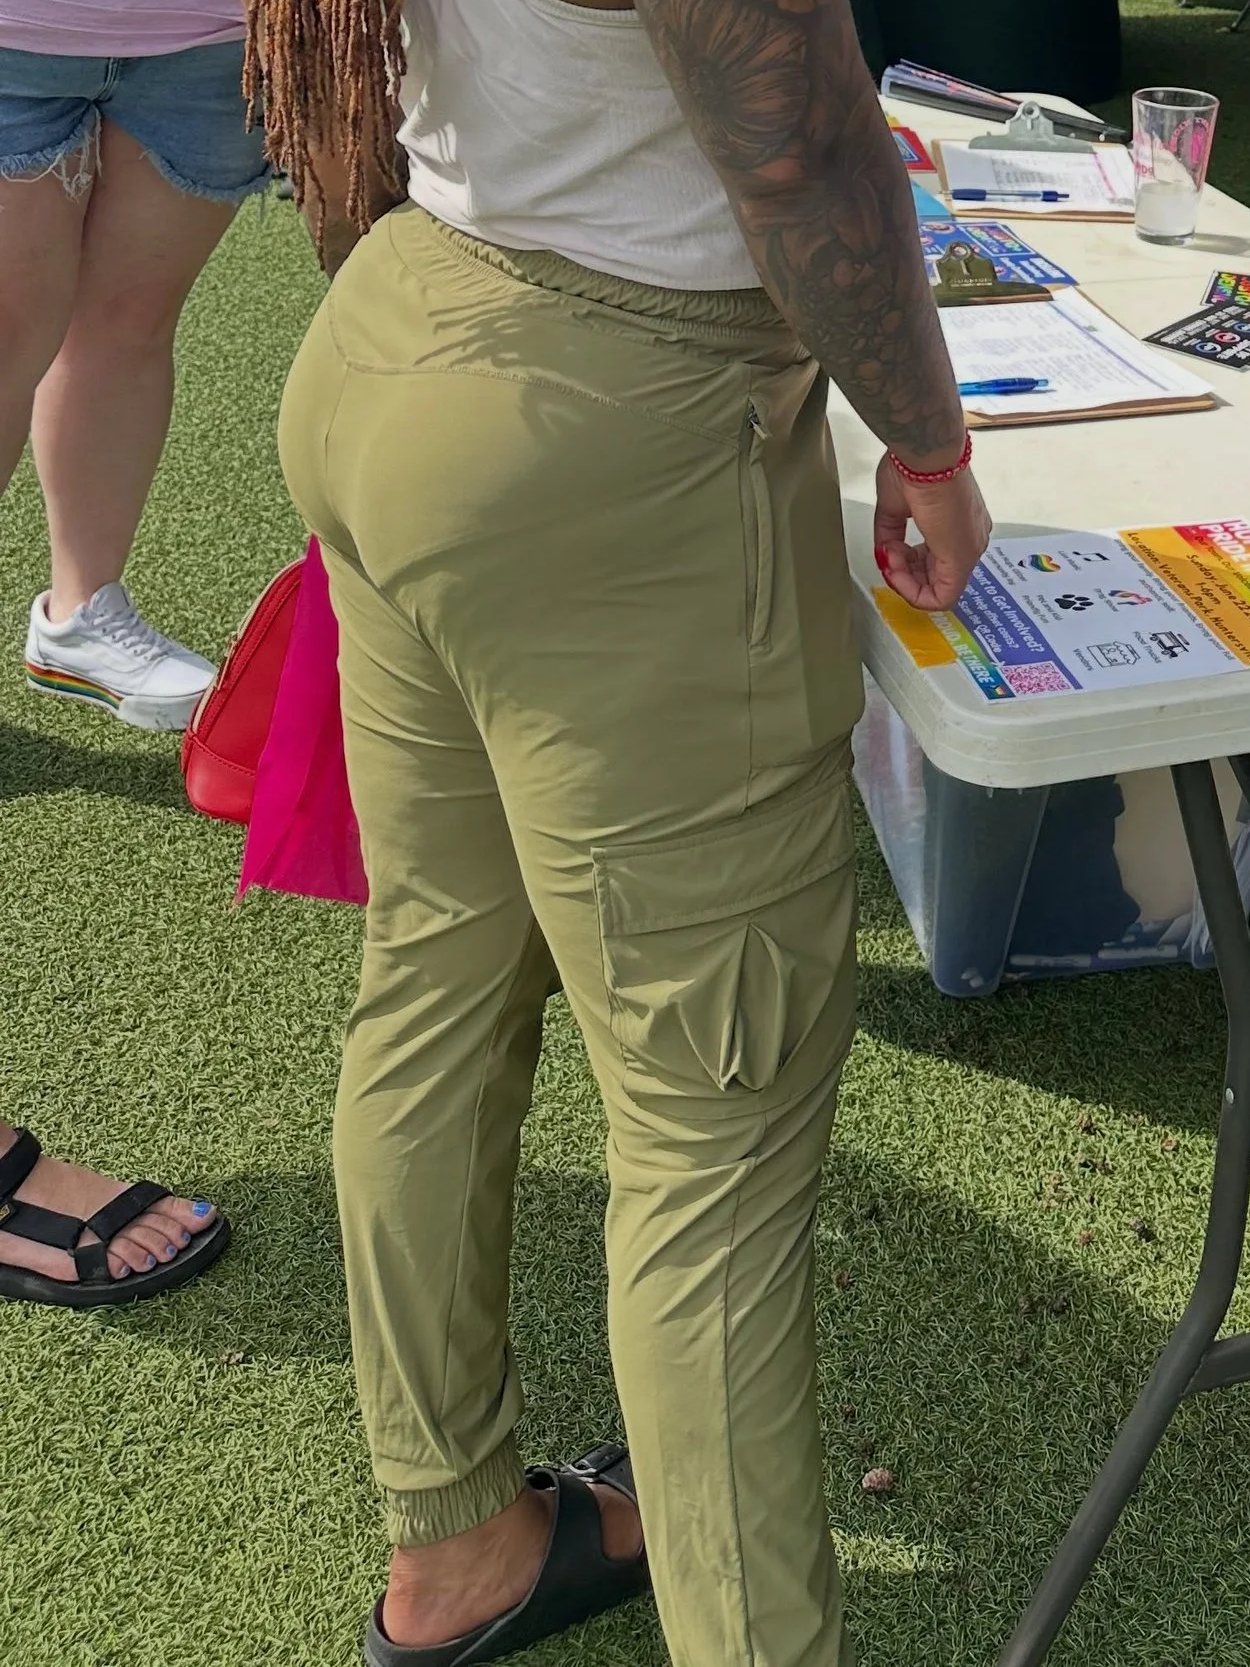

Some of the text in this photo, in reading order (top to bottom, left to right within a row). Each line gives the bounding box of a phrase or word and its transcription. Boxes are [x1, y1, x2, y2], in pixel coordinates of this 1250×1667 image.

[1129, 532, 1163, 563] Location:
[1160, 563, 1194, 596] Veterans
[1198, 581, 1221, 605] 1-6pm
[1217, 582, 1238, 600] June
[1234, 599, 1249, 611] 22
[958, 599, 1003, 653] Scan the QR Code
[971, 595, 988, 611] Help
[984, 609, 1002, 627] offset
[996, 626, 1018, 649] costs?
[984, 585, 997, 595] to
[993, 594, 1010, 610] Get
[1002, 609, 1045, 653] Involved?
[1073, 648, 1093, 671] Vendors
[1134, 631, 1163, 664] Food Trucks
